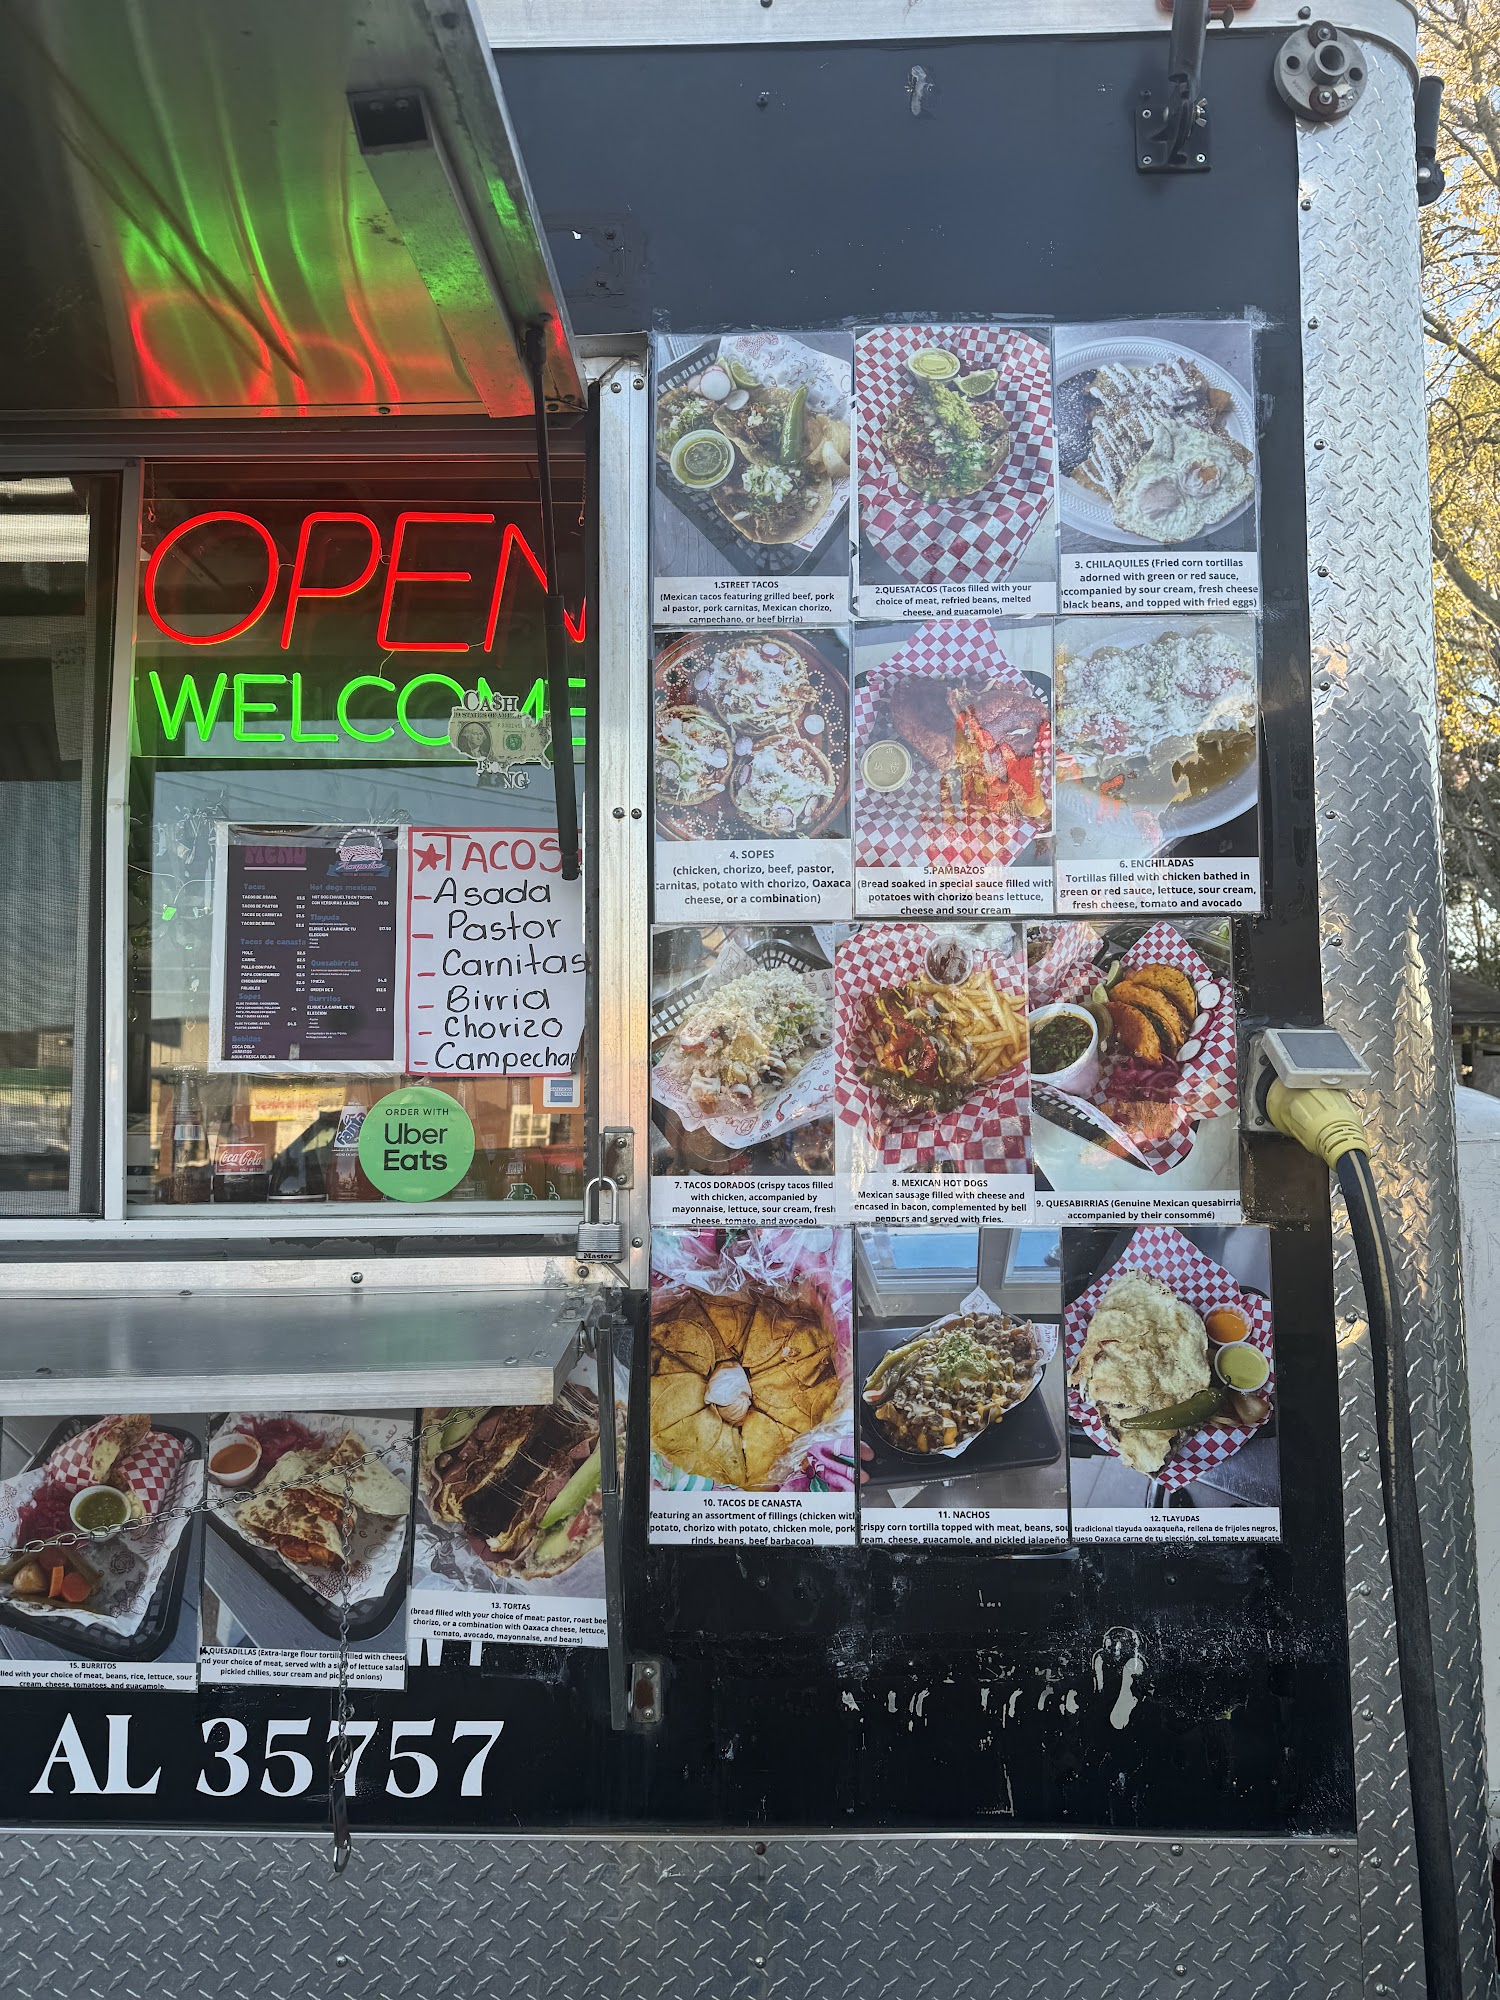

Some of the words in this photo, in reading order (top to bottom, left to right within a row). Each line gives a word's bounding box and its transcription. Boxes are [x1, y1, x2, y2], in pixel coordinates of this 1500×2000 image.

[1074, 560, 1082, 569] 3.
[1085, 559, 1149, 568] CHILAQUILES
[1151, 559, 1179, 568] (Fried
[1205, 558, 1243, 567] tortillas
[144, 510, 586, 652] OPEN
[1079, 573, 1120, 581] adorned
[1122, 572, 1144, 580] with
[1147, 573, 1175, 582] green
[1190, 572, 1206, 580] red
[1208, 573, 1238, 581] sauce,
[875, 585, 937, 594] 2.QUESATACOS
[939, 585, 965, 593] (Tacos
[967, 584, 988, 592] filled
[1012, 585, 1031, 593] your
[723, 592, 762, 601] featuring
[763, 592, 790, 601] grilled
[792, 592, 812, 601] beef,
[815, 592, 834, 601] pork
[875, 597, 902, 605] choice
[941, 596, 970, 604] refried
[972, 596, 999, 604] beans,
[662, 604, 670, 612] al
[672, 605, 700, 613] pastor,
[703, 604, 722, 613] pork
[724, 604, 760, 612] carnitas,
[799, 604, 831, 612] chorizo,
[422, 833, 562, 873] TACOS
[729, 850, 738, 860] 4.
[741, 849, 774, 859] SOPES
[1119, 860, 1127, 868] 6.
[1131, 858, 1194, 867] ENCHILADAS
[672, 865, 720, 876] (chicken,
[723, 865, 764, 875] chorizo,
[768, 864, 793, 875] beef,
[797, 865, 834, 875] pastor,
[923, 866, 984, 874] 5.PAMBAZOS
[1065, 873, 1106, 882] Tortillas
[1109, 873, 1134, 881] filled
[1136, 872, 1159, 881] with
[1162, 872, 1200, 880] chicken
[1203, 871, 1237, 880] bathed
[1240, 871, 1249, 880] in
[434, 877, 551, 906] Asada
[913, 892, 934, 901] with
[937, 892, 972, 901] chorizo
[1006, 893, 1043, 901] lettuce,
[684, 896, 723, 905] cheese,
[749, 893, 820, 903] combination)
[448, 910, 562, 941] Pastor
[442, 944, 587, 976] Carnitas
[446, 984, 550, 1013] Birria
[444, 1014, 563, 1038] Chorizo
[385, 1108, 419, 1116] ORDER
[384, 1123, 448, 1144] Uber
[384, 1150, 448, 1170] Eats
[674, 1181, 681, 1189] 7.
[757, 1181, 785, 1190] (crispy
[891, 1179, 899, 1187] 8.
[963, 1179, 987, 1187] DOGS
[711, 1193, 746, 1201] chicken,
[748, 1193, 804, 1201] accompanied
[807, 1193, 817, 1202] by
[895, 1192, 929, 1200] sausage
[955, 1191, 974, 1199] with
[1008, 1191, 1024, 1199] and
[1036, 1199, 1043, 1208] 9.
[1045, 1199, 1108, 1207] QUESABIRRIAS
[1110, 1199, 1150, 1207] (Genuine
[1153, 1199, 1189, 1207] Mexican
[1067, 1211, 1125, 1219] accompanied
[1128, 1211, 1138, 1221] by
[703, 1498, 715, 1507] 10.
[717, 1498, 745, 1506] TACOS
[748, 1499, 759, 1507] DE
[761, 1499, 802, 1507] CANASTA
[938, 1510, 950, 1519] 11.
[952, 1510, 990, 1518] NACHOS
[502, 1602, 530, 1610] TORTAS
[30, 1712, 162, 1795] AL
[196, 1716, 504, 1798] 35757
